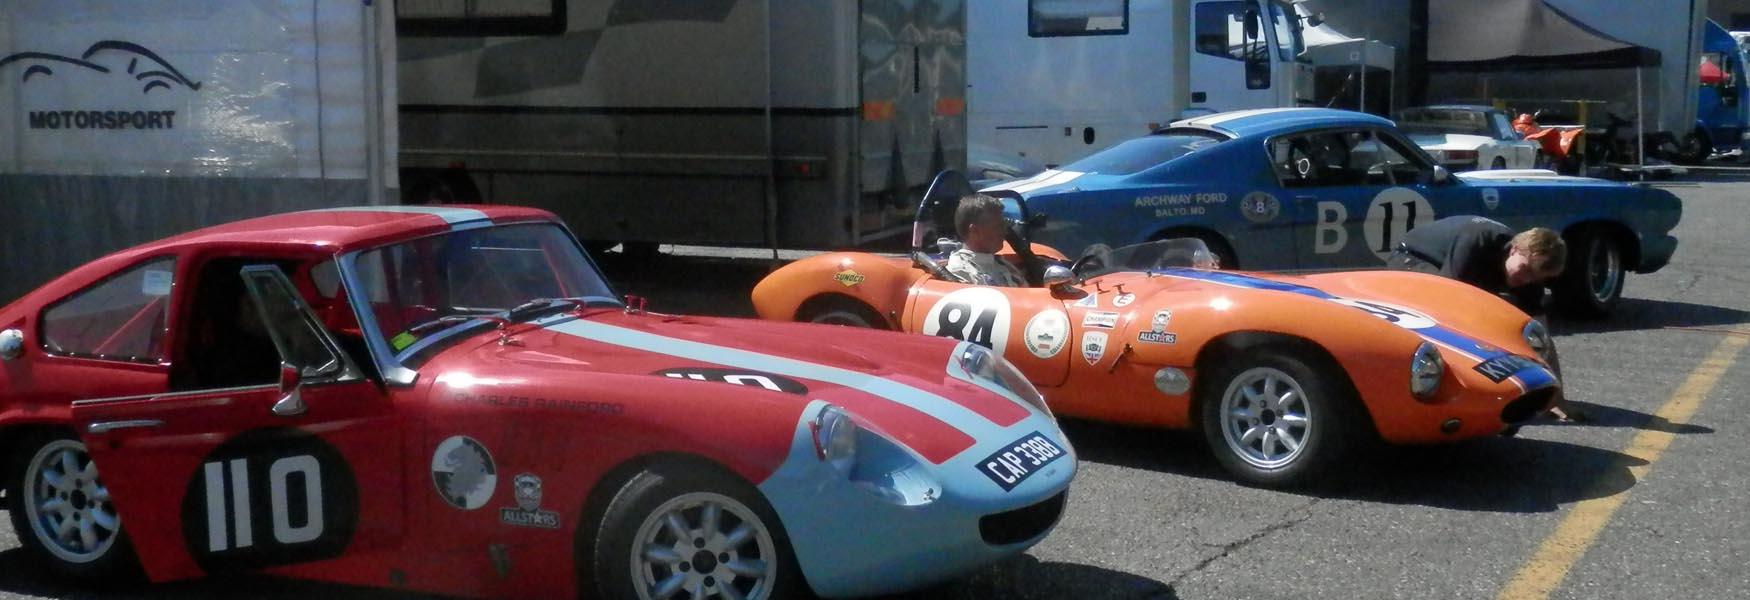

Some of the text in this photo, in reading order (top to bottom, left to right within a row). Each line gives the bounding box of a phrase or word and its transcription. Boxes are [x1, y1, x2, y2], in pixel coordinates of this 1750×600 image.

[29, 110, 176, 130] MOTORSPORT
[1135, 192, 1228, 207] ARCHWAY FORD
[1315, 200, 1348, 254] B
[987, 435, 1060, 484] CAP 338B
[204, 454, 324, 552] 110
